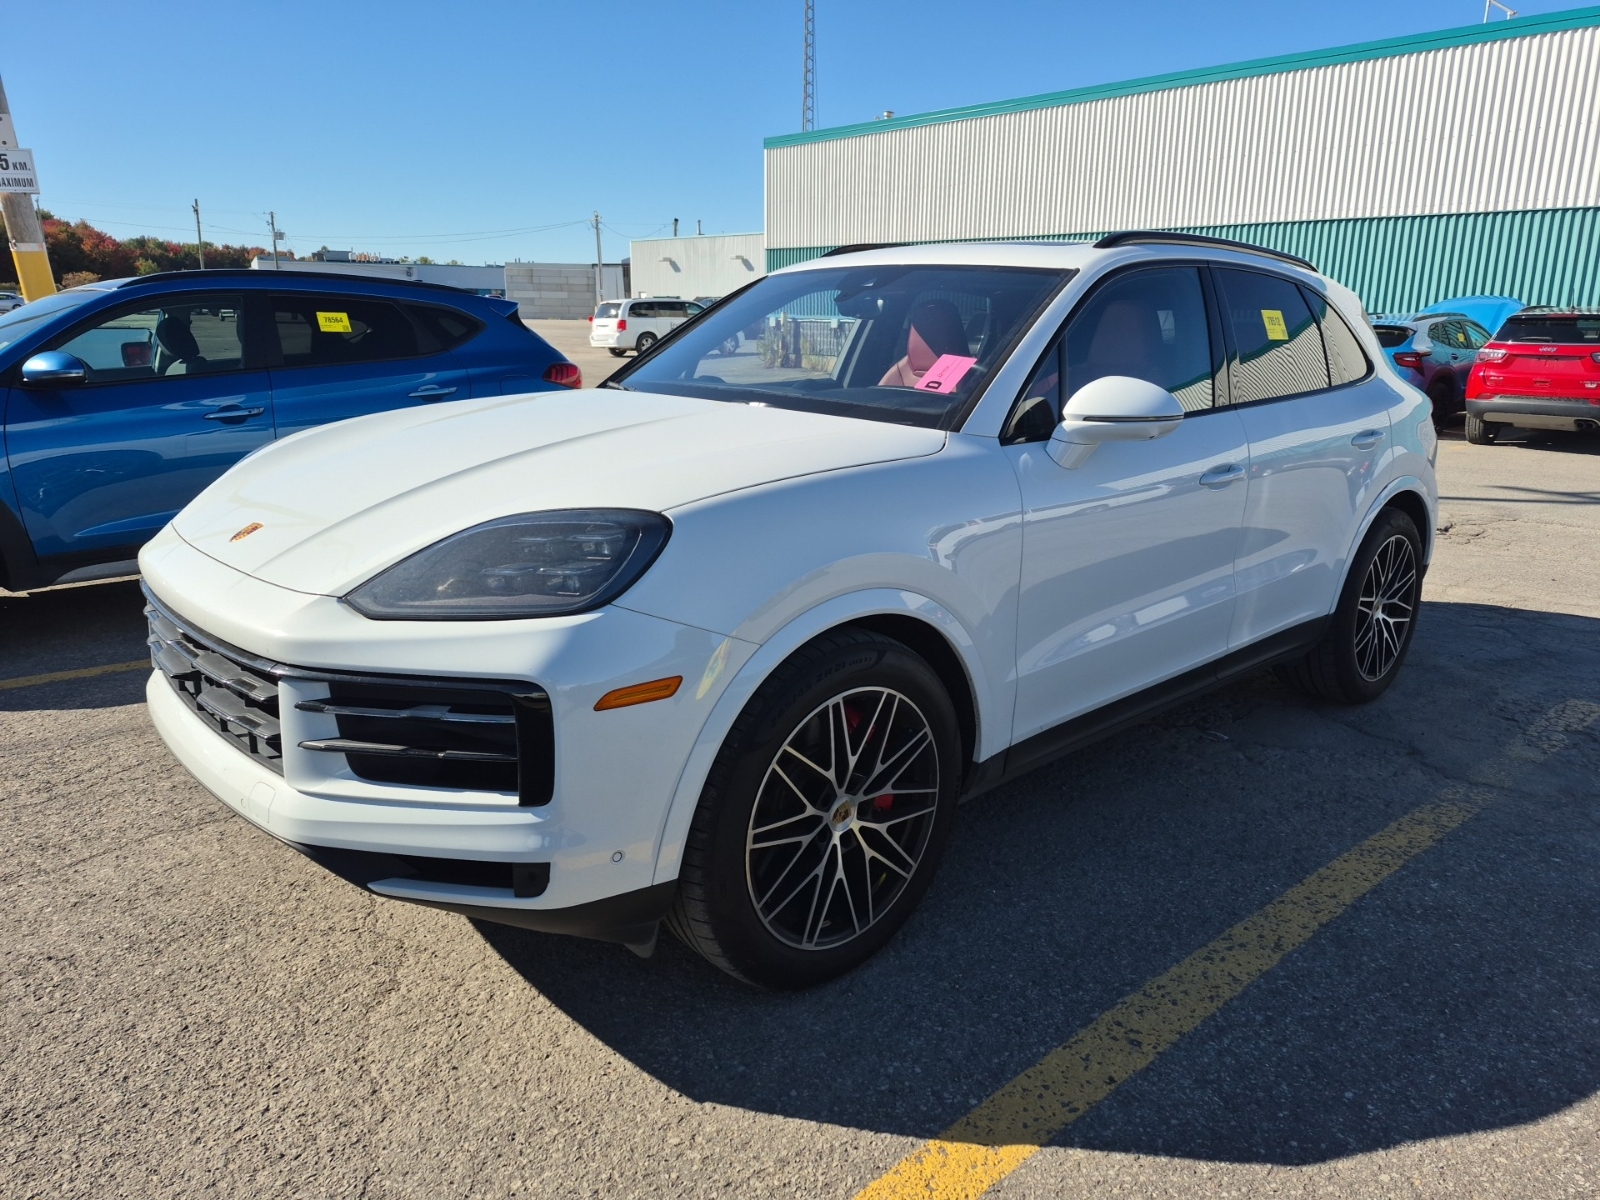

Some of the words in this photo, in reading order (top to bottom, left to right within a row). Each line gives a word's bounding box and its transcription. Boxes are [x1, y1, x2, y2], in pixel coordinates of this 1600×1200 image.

[0, 153, 10, 171] 5
[12, 161, 31, 171] KM.
[0, 177, 35, 188] AXIMUM
